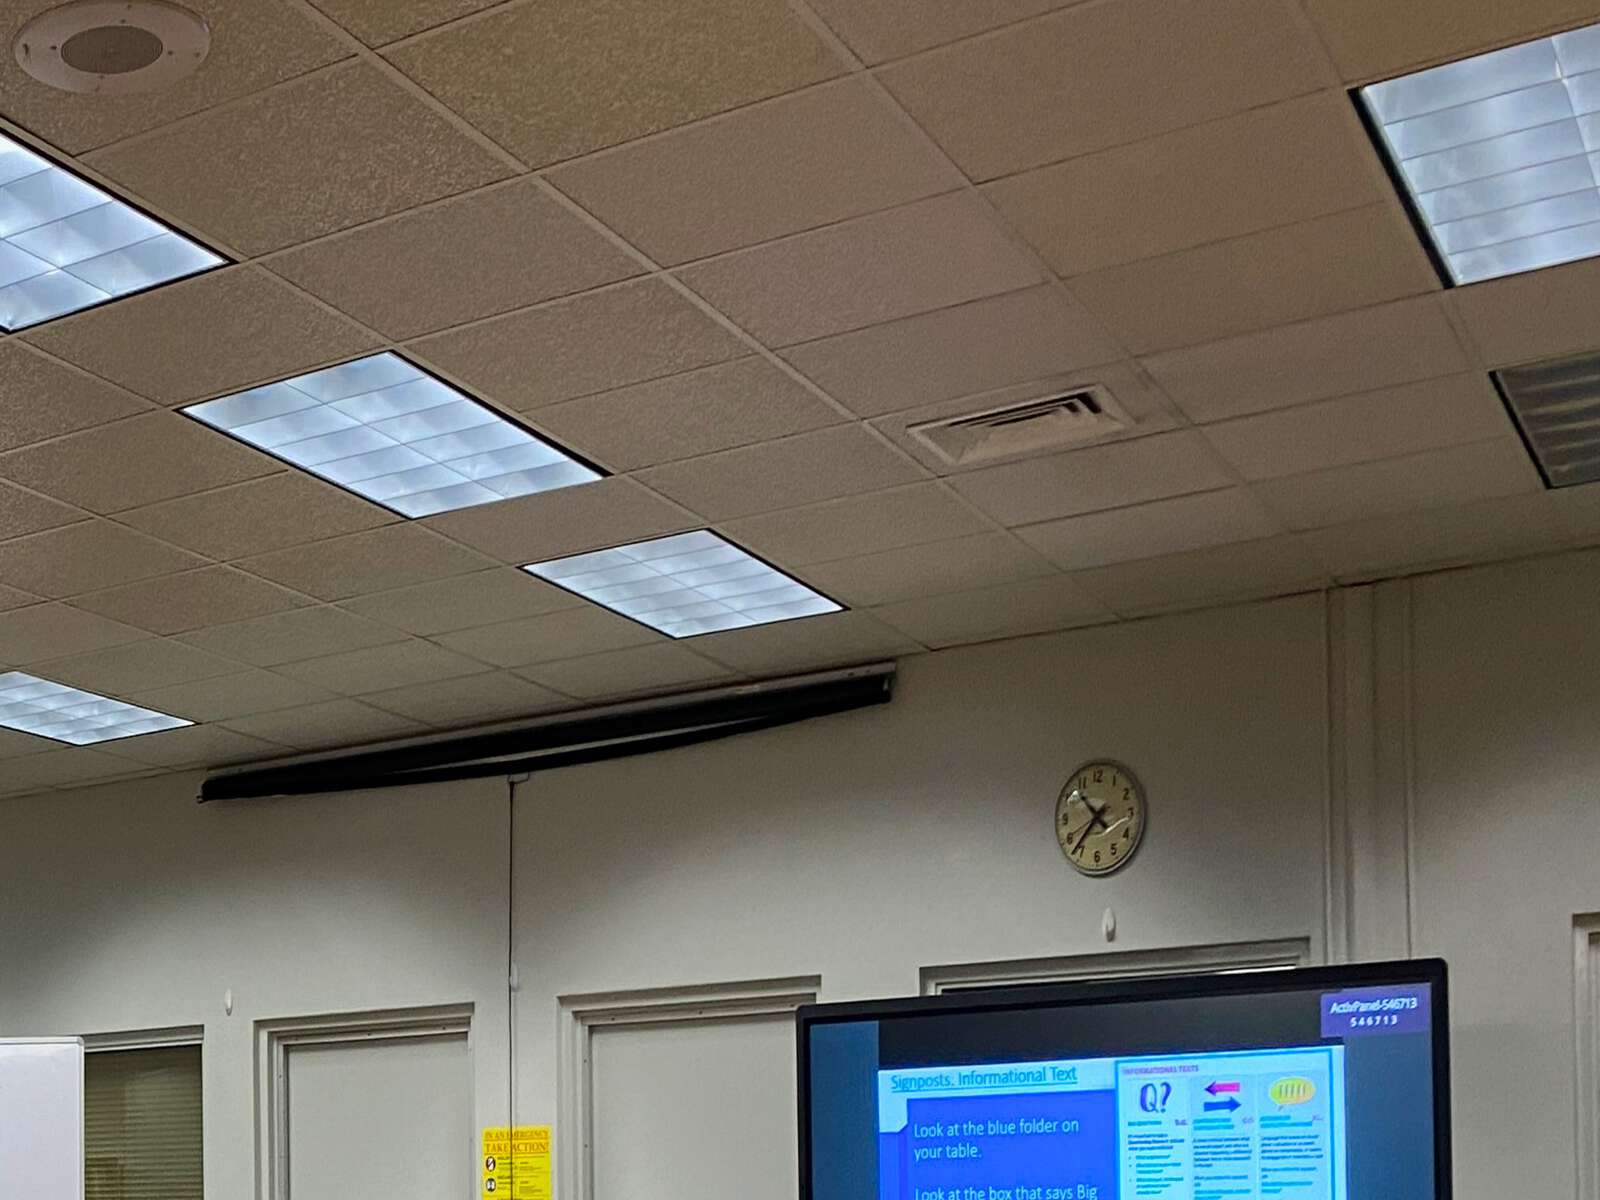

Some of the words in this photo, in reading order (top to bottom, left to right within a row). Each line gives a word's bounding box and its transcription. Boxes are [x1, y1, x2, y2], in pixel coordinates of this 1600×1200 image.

[1093, 770, 1103, 783] 12
[1078, 777, 1087, 789] 11
[1123, 788, 1130, 800] 2
[1061, 813, 1069, 825] 9
[1122, 827, 1130, 840] 4
[1078, 846, 1085, 858] 7
[1110, 843, 1118, 855] 5
[1094, 851, 1101, 863] 6
[958, 1066, 1047, 1087] Informational
[1049, 1066, 1077, 1082] Text
[914, 1123, 944, 1138] Look
[947, 1123, 960, 1137] at
[963, 1121, 984, 1136] the
[988, 1120, 1016, 1135] blue
[1019, 1118, 1058, 1134] folder
[1062, 1120, 1079, 1132] on
[486, 1143, 508, 1152] TAKE
[914, 1146, 942, 1162] your
[946, 1143, 982, 1159] table.
[989, 1186, 1012, 1200] box
[1016, 1185, 1042, 1200] that
